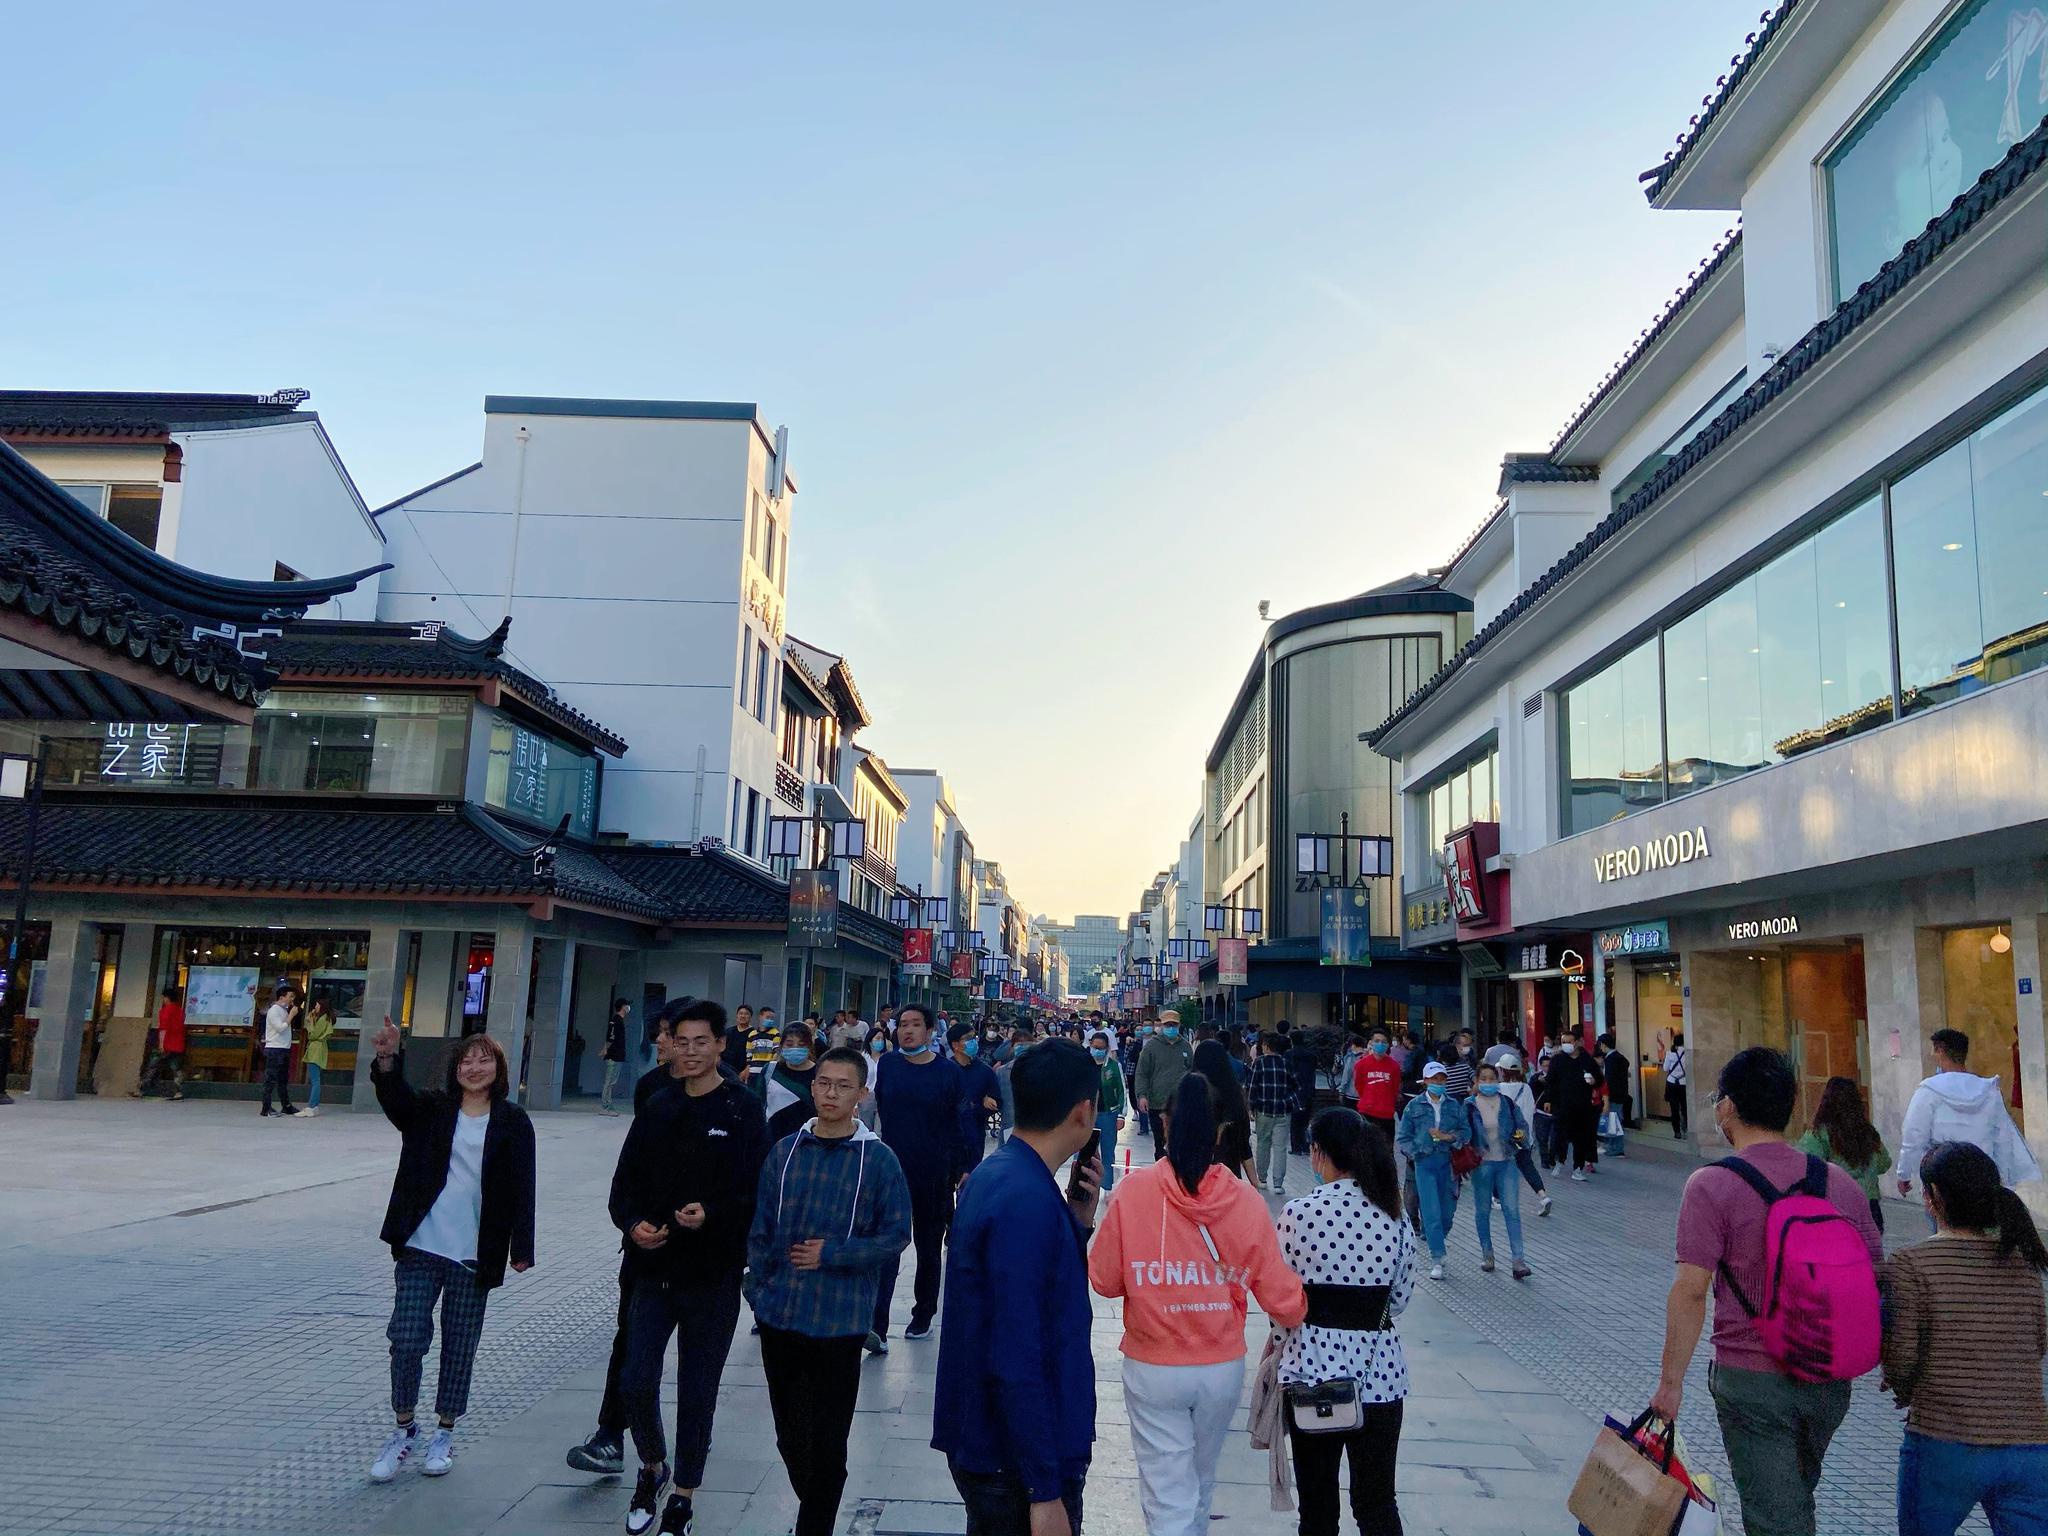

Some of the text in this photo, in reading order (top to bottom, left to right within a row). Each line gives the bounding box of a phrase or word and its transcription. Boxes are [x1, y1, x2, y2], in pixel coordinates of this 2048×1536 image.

[1594, 826, 1711, 884] VERO MODA
[1728, 916, 1798, 940] VERO MODA
[1568, 975, 1587, 983] KFC
